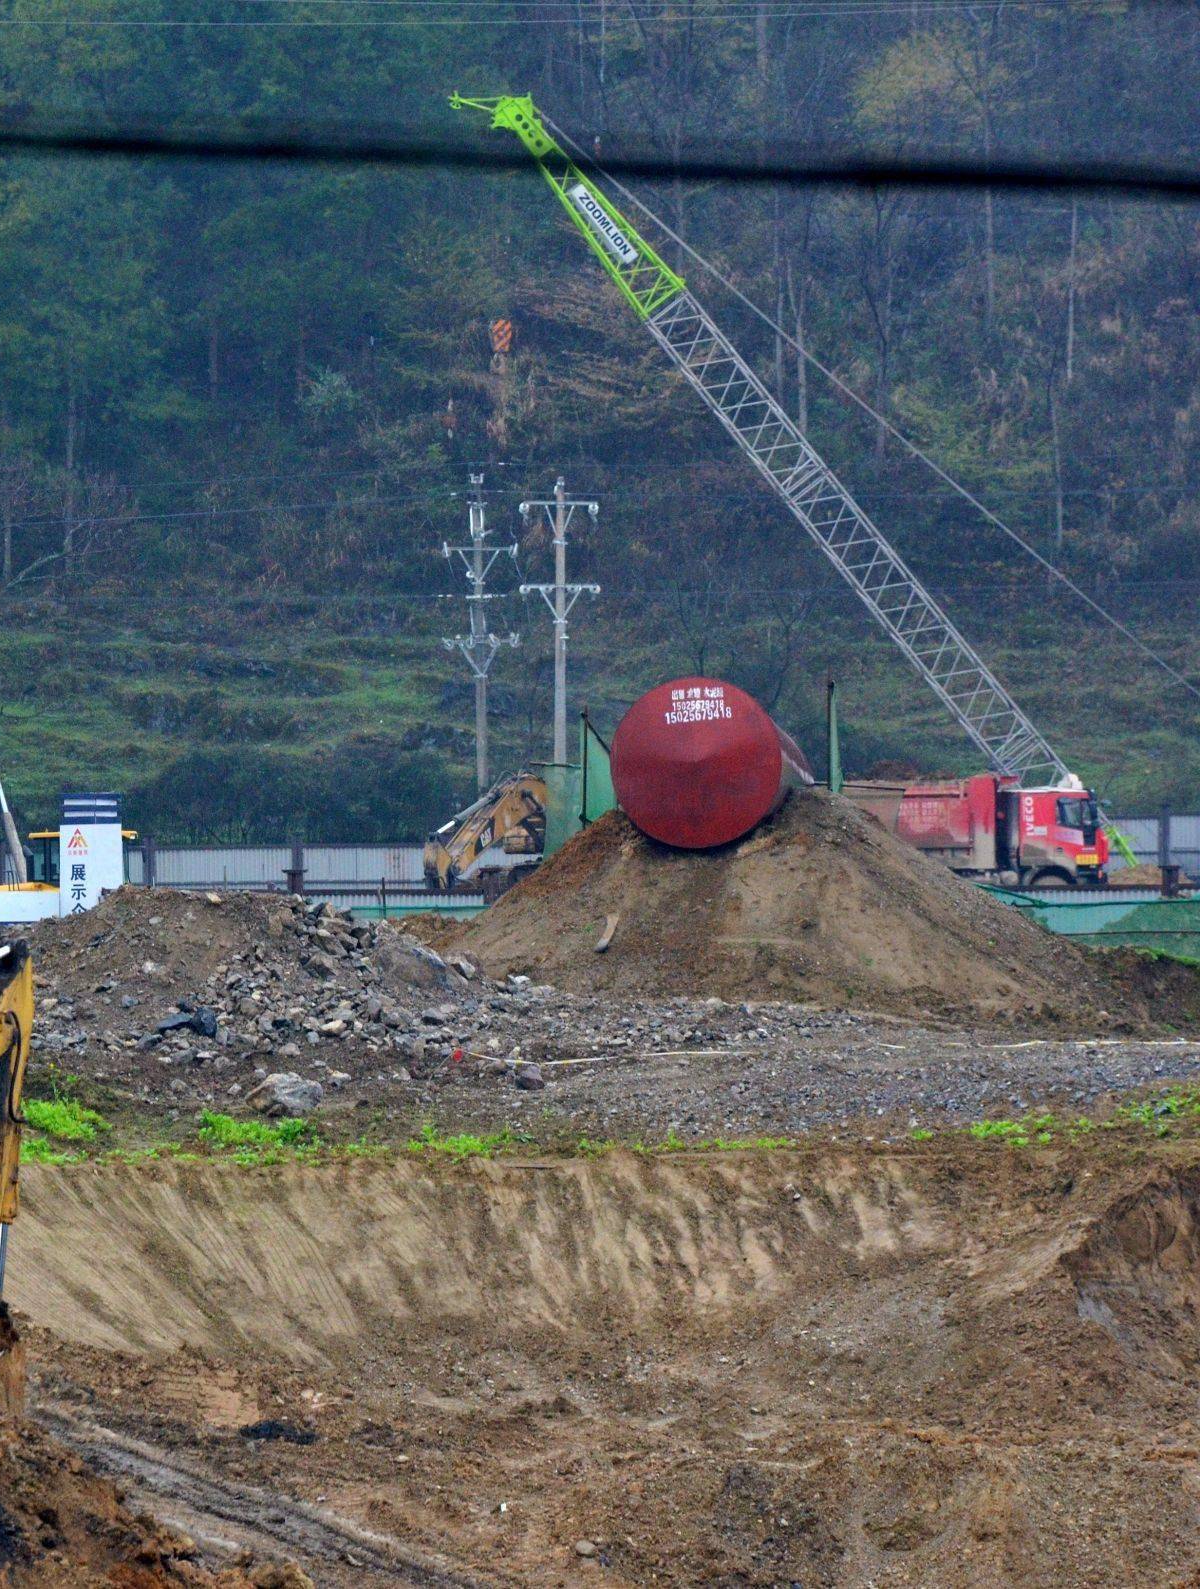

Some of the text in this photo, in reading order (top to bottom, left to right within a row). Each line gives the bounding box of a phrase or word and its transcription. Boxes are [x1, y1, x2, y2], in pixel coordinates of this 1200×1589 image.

[579, 192, 631, 255] ZOOMLION
[665, 706, 732, 724] 15025679418
[1024, 796, 1034, 836] IVECO
